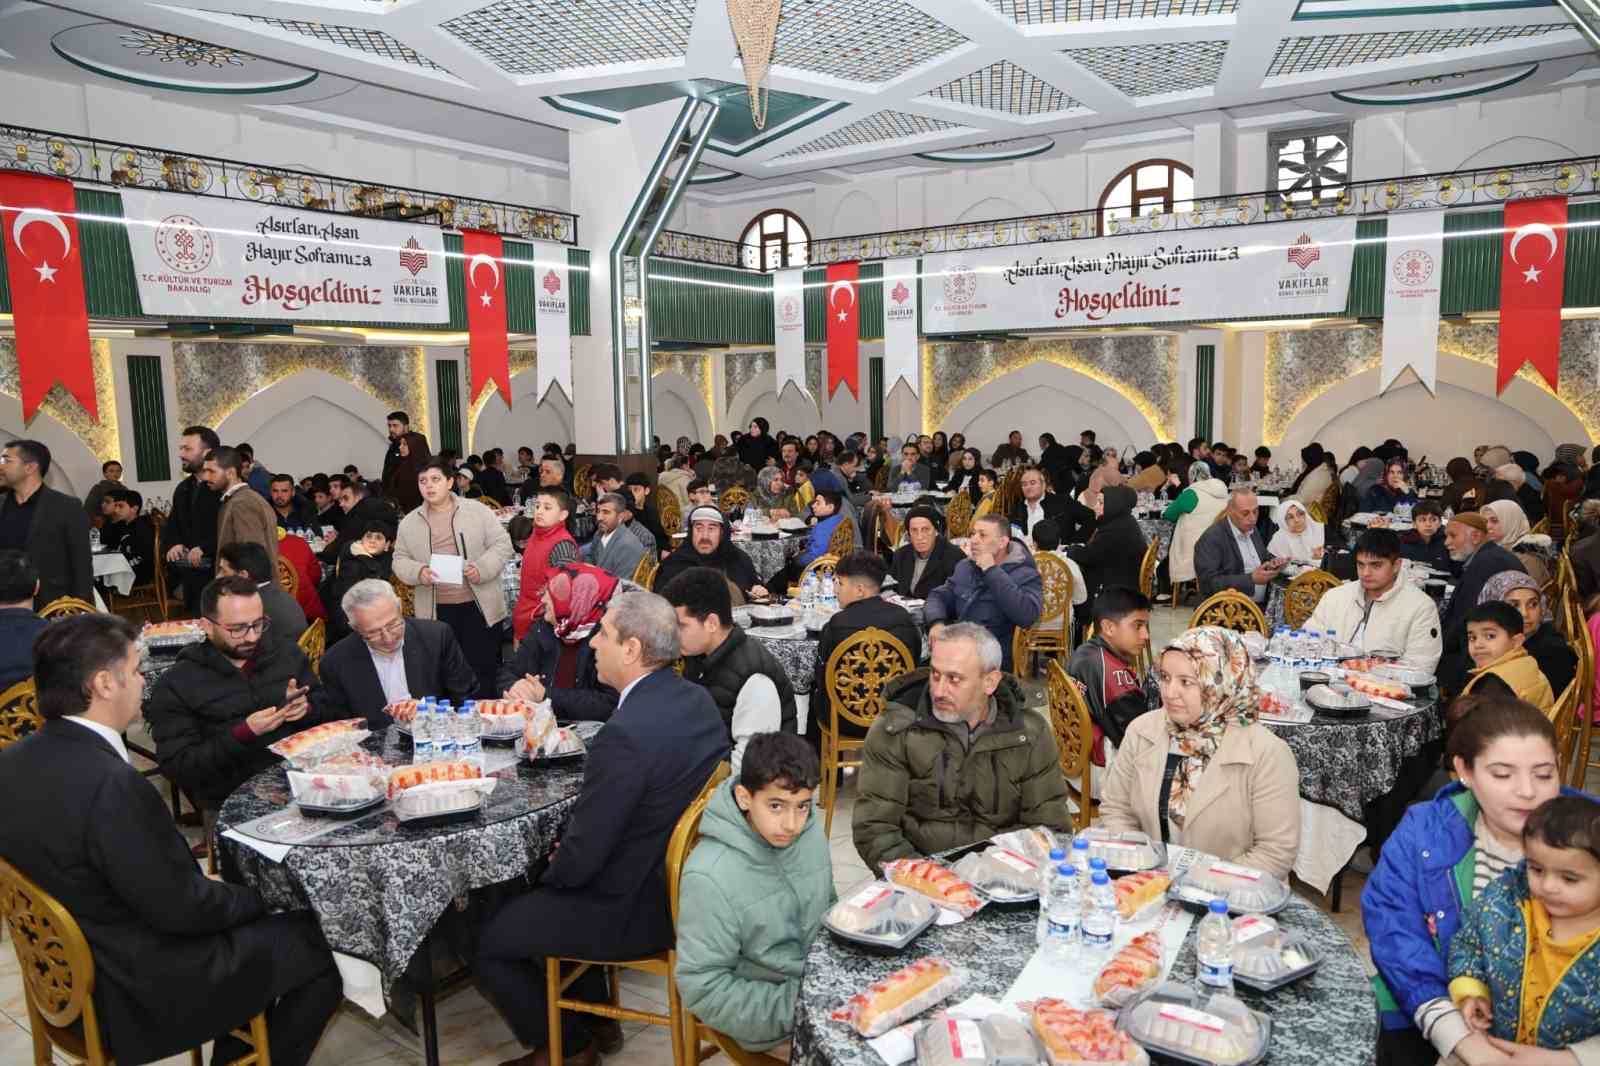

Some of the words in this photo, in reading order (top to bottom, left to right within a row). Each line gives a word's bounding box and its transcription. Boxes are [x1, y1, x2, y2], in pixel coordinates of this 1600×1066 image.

[256, 216, 318, 238] Asırları
[318, 222, 360, 241] Aşan
[245, 242, 293, 265] Hayır
[294, 246, 373, 266] Soframıza
[242, 275, 382, 310] Hoşgeldiniz
[393, 285, 437, 296] VAKIFLAR
[1279, 277, 1328, 289] VAKIFLAR
[1056, 281, 1182, 320] Hoşgeldiniz
